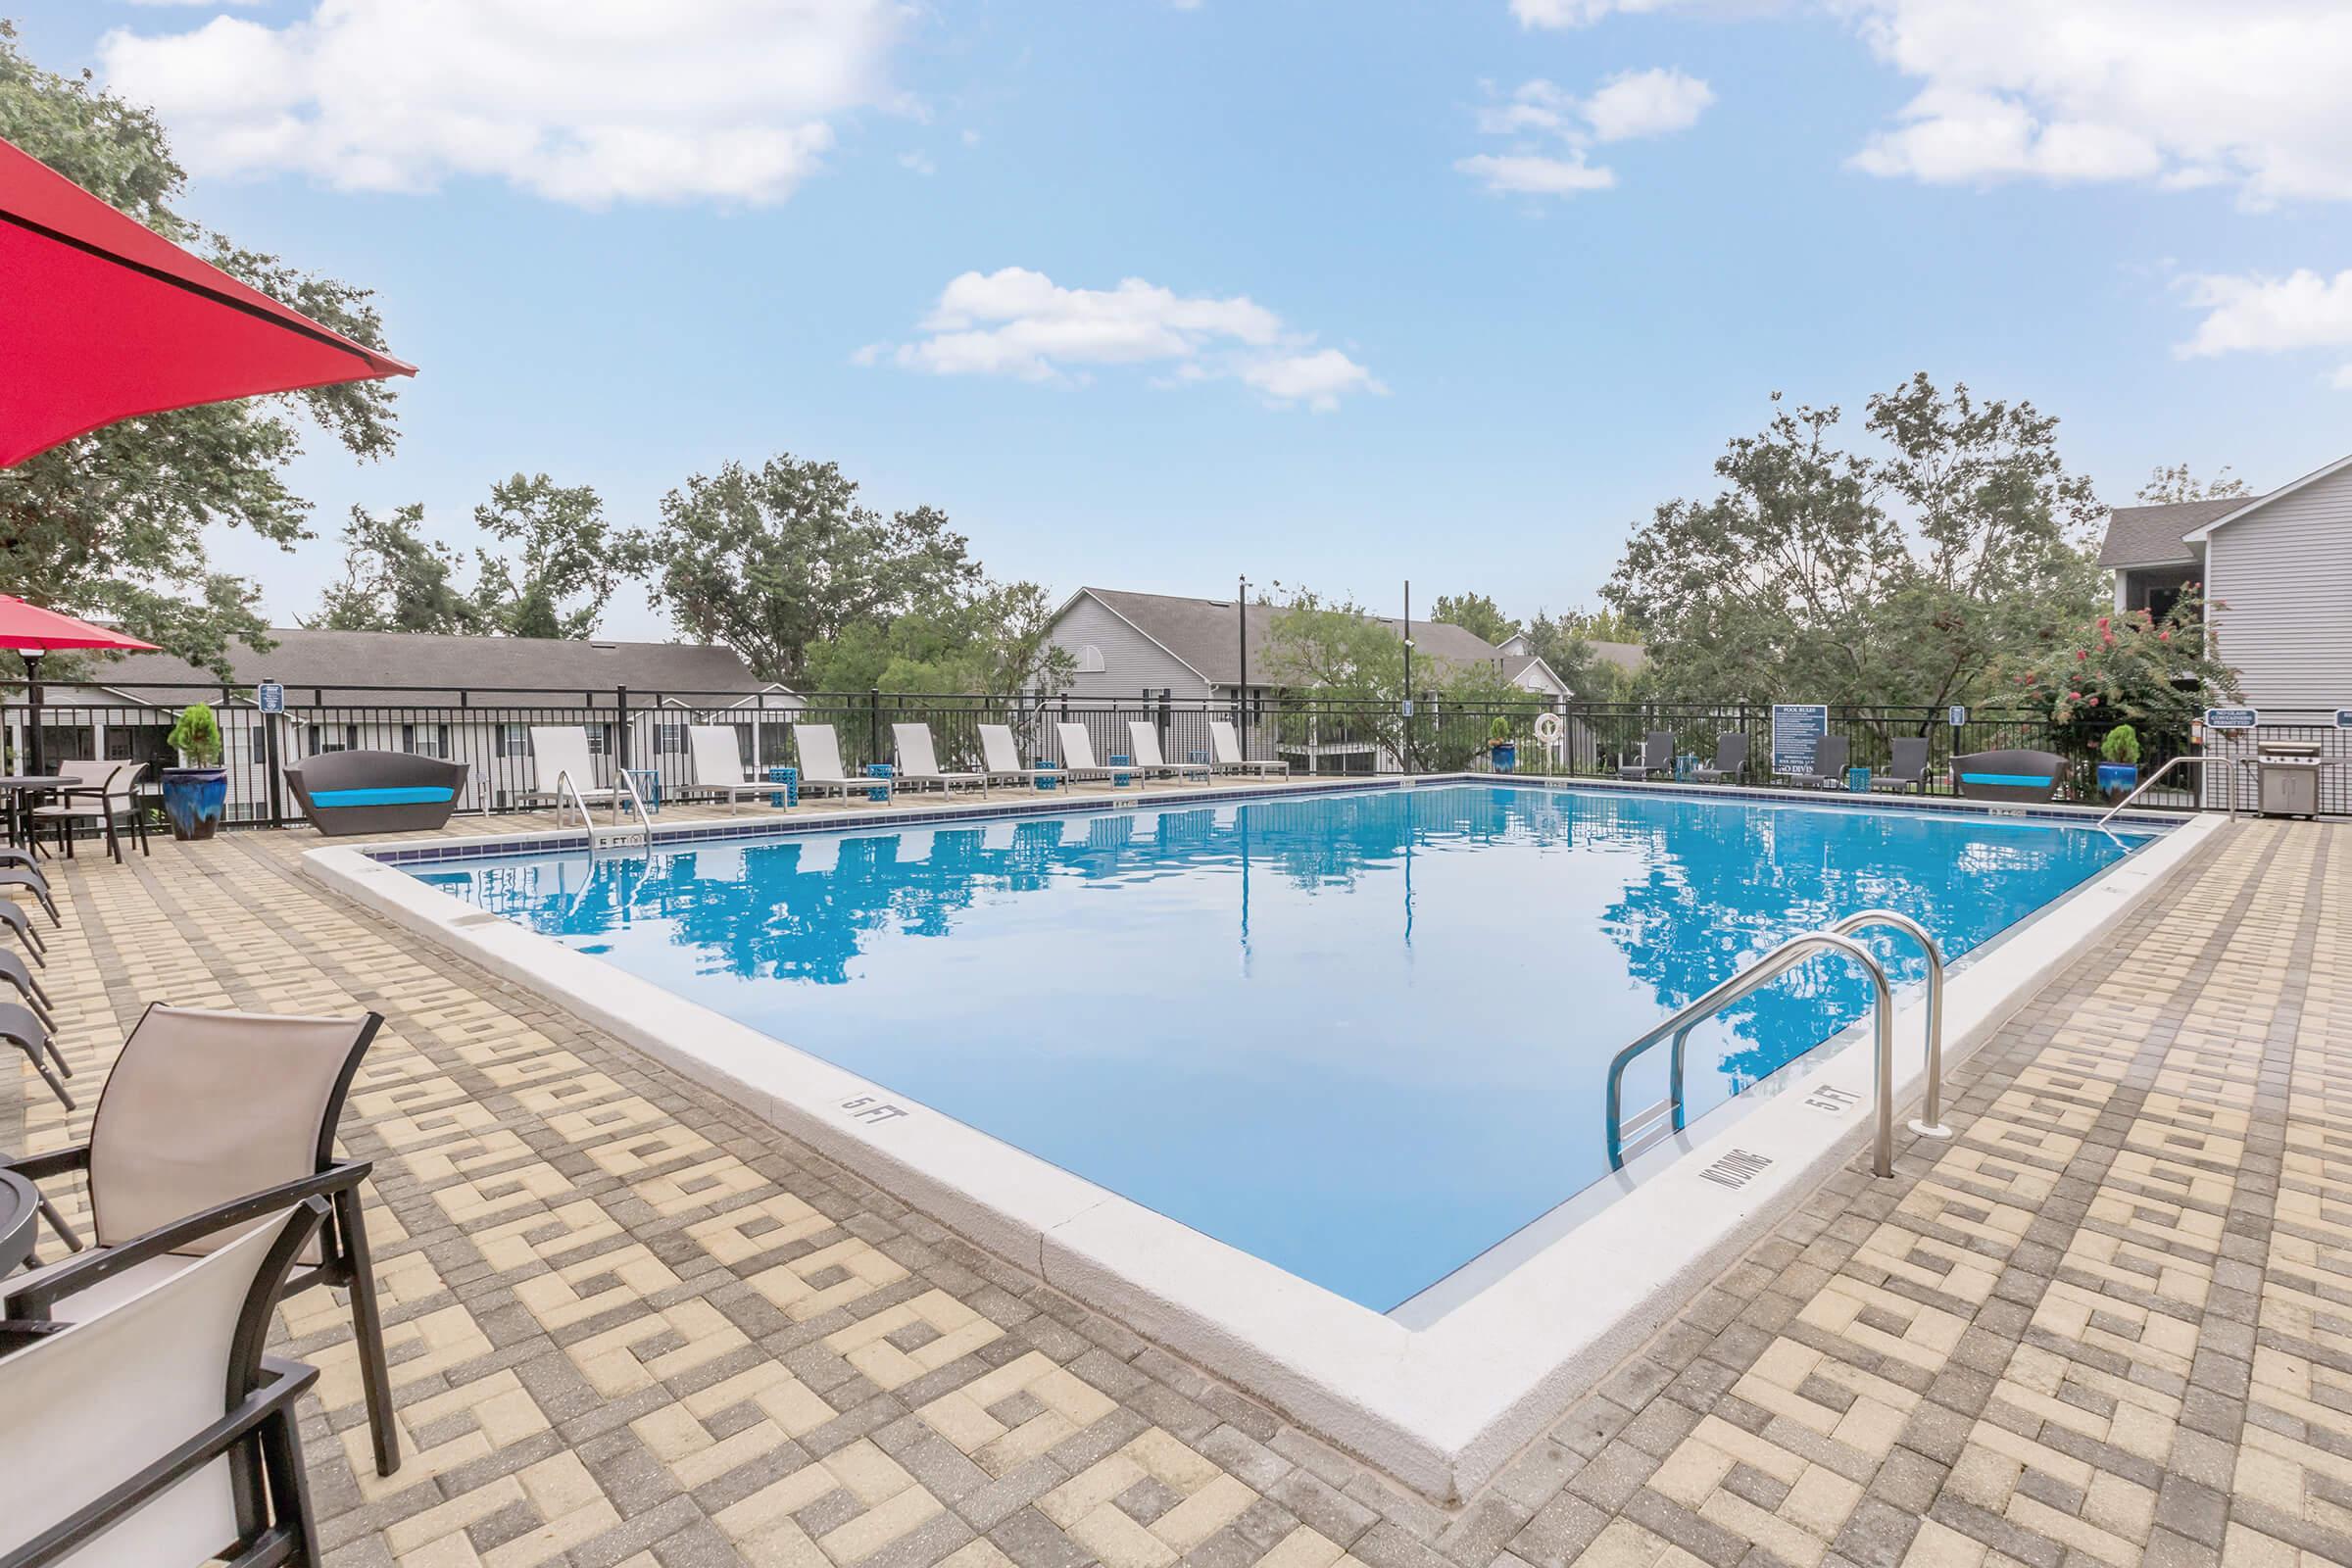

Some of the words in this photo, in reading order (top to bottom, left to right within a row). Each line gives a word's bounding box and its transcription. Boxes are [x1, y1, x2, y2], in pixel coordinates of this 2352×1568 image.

[1813, 1084, 1861, 1105] FT
[841, 1097, 876, 1109] 5
[1804, 1099, 1839, 1112] 5
[854, 1104, 909, 1124] FT
